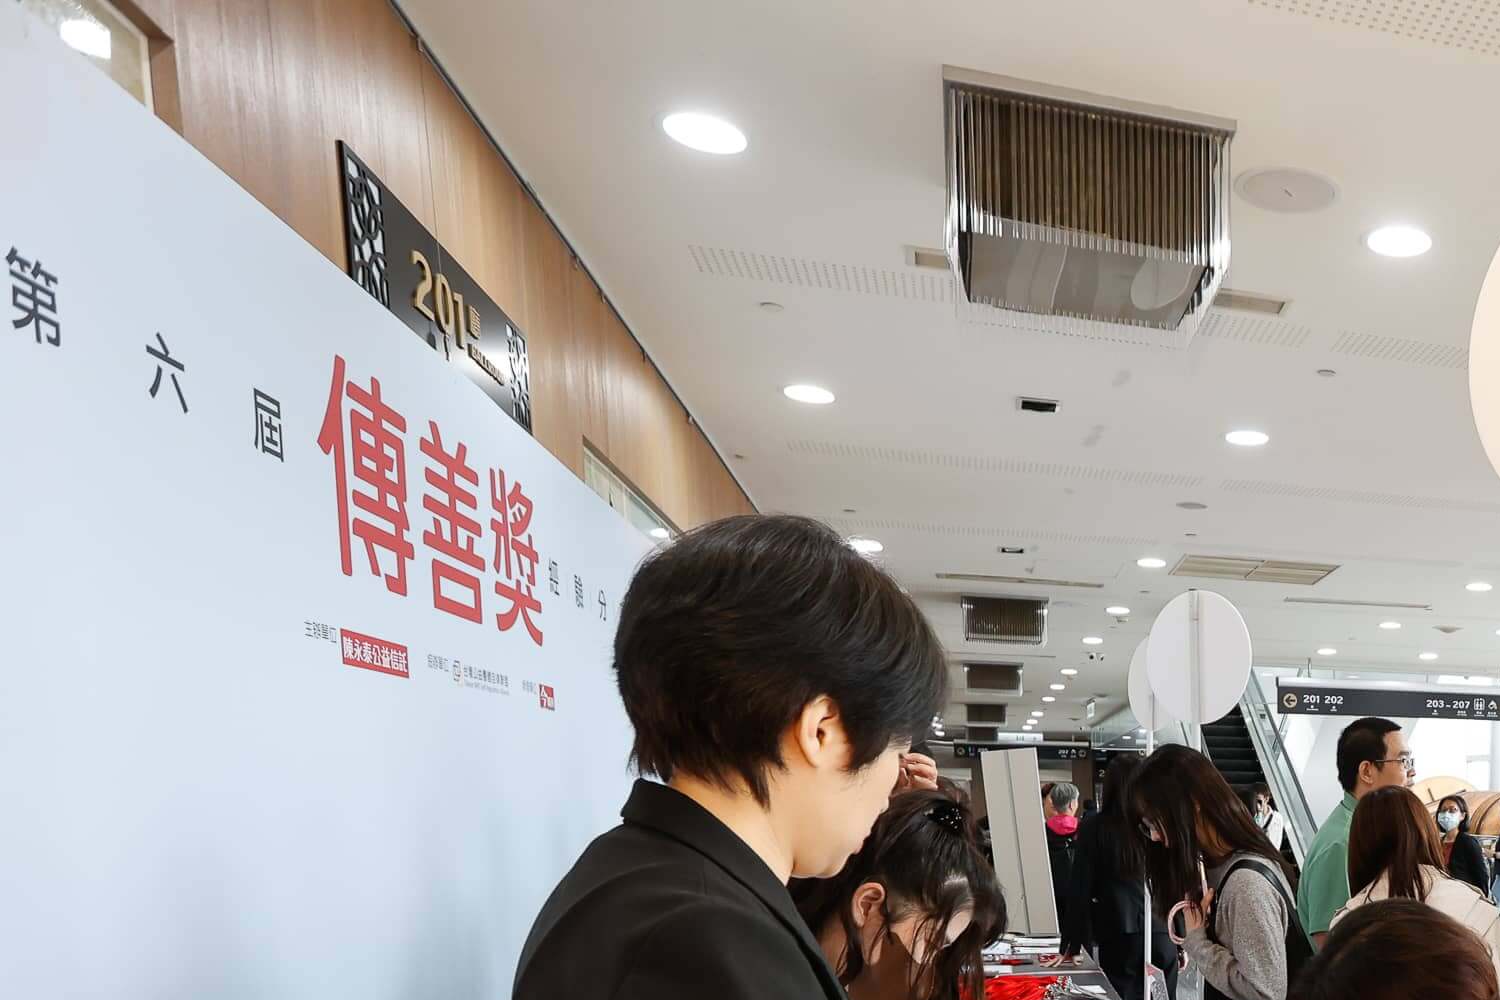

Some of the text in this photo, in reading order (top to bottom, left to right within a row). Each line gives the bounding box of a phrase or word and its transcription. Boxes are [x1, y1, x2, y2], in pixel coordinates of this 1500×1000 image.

[410, 250, 465, 350] 201
[317, 354, 544, 647] 傳善獎
[1303, 694, 1344, 705] 201 202
[1426, 699, 1444, 708] 203
[1452, 700, 1470, 709] 207
